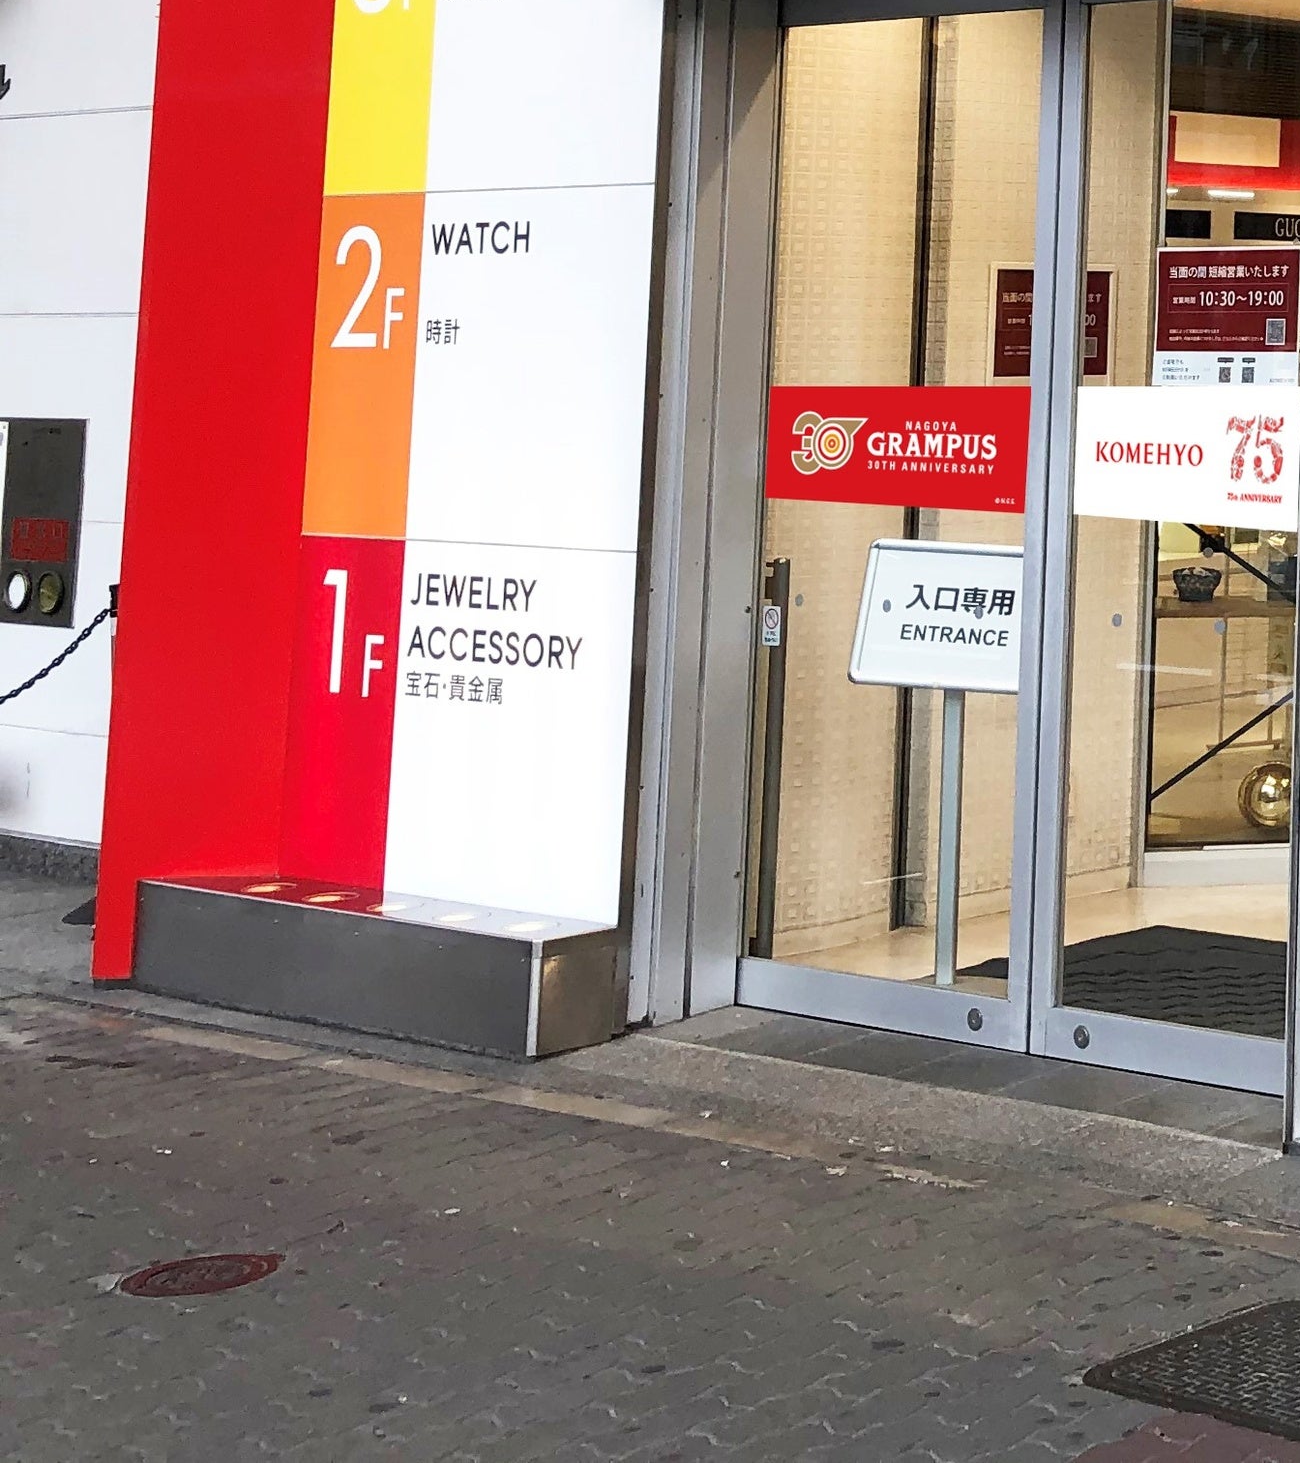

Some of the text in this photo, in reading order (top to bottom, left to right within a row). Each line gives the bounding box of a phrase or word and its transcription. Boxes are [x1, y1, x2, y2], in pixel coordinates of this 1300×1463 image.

[432, 220, 531, 256] WATCH
[330, 225, 405, 349] 2F
[1169, 263, 1290, 280] 当面の間 短縮営業いたします
[425, 318, 461, 346] 時計
[905, 420, 957, 432] NAGOYA
[867, 431, 998, 460] GRAMPUS
[1095, 441, 1204, 467] KOMEHYO
[1226, 414, 1285, 484] 75
[867, 460, 995, 475] 30TH ANNIVERSARY
[411, 573, 538, 613] JEWELRY
[905, 584, 1016, 617] 入口専用
[322, 568, 385, 699] 1F
[407, 624, 584, 672] ACCESSORY
[900, 624, 1010, 647] ENTRANCE
[404, 671, 504, 705] 宝石・貴金属
